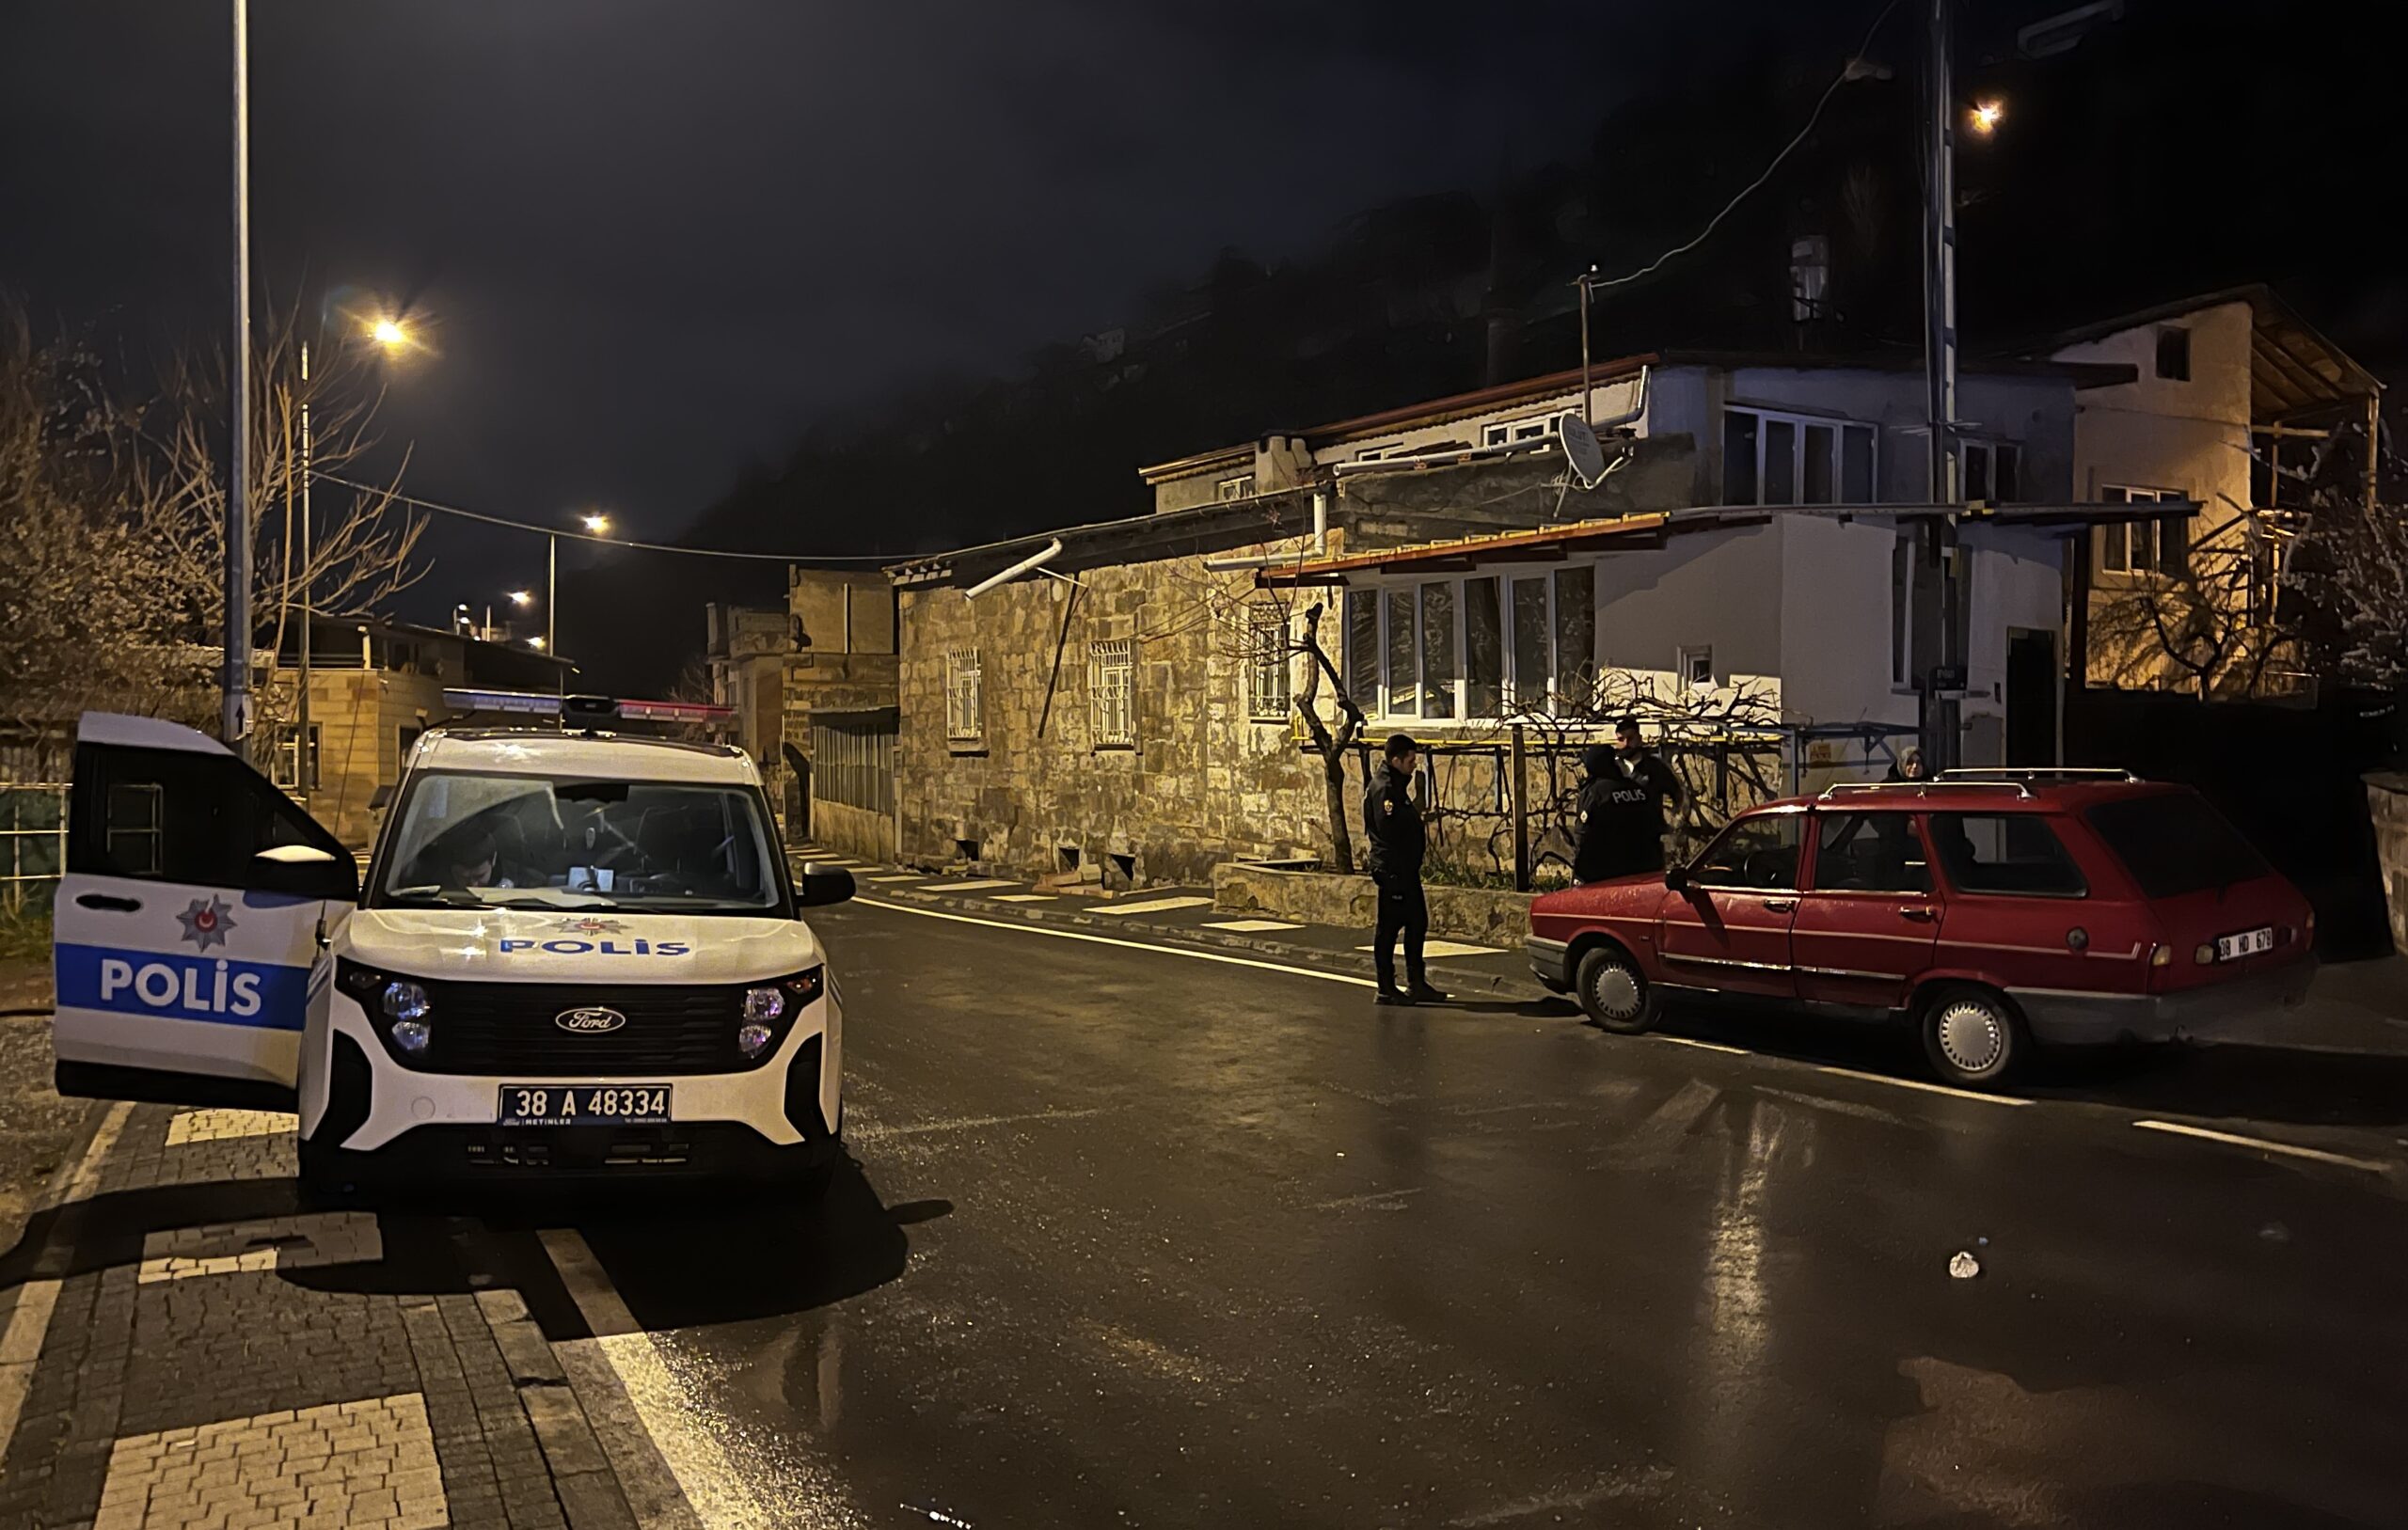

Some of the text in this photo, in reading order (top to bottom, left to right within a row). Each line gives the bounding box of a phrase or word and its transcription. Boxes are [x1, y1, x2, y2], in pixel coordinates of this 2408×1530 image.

[2220, 939, 2231, 957] 38
[568, 1011, 611, 1029] Ford
[515, 1090, 664, 1116] 38 A 48334
